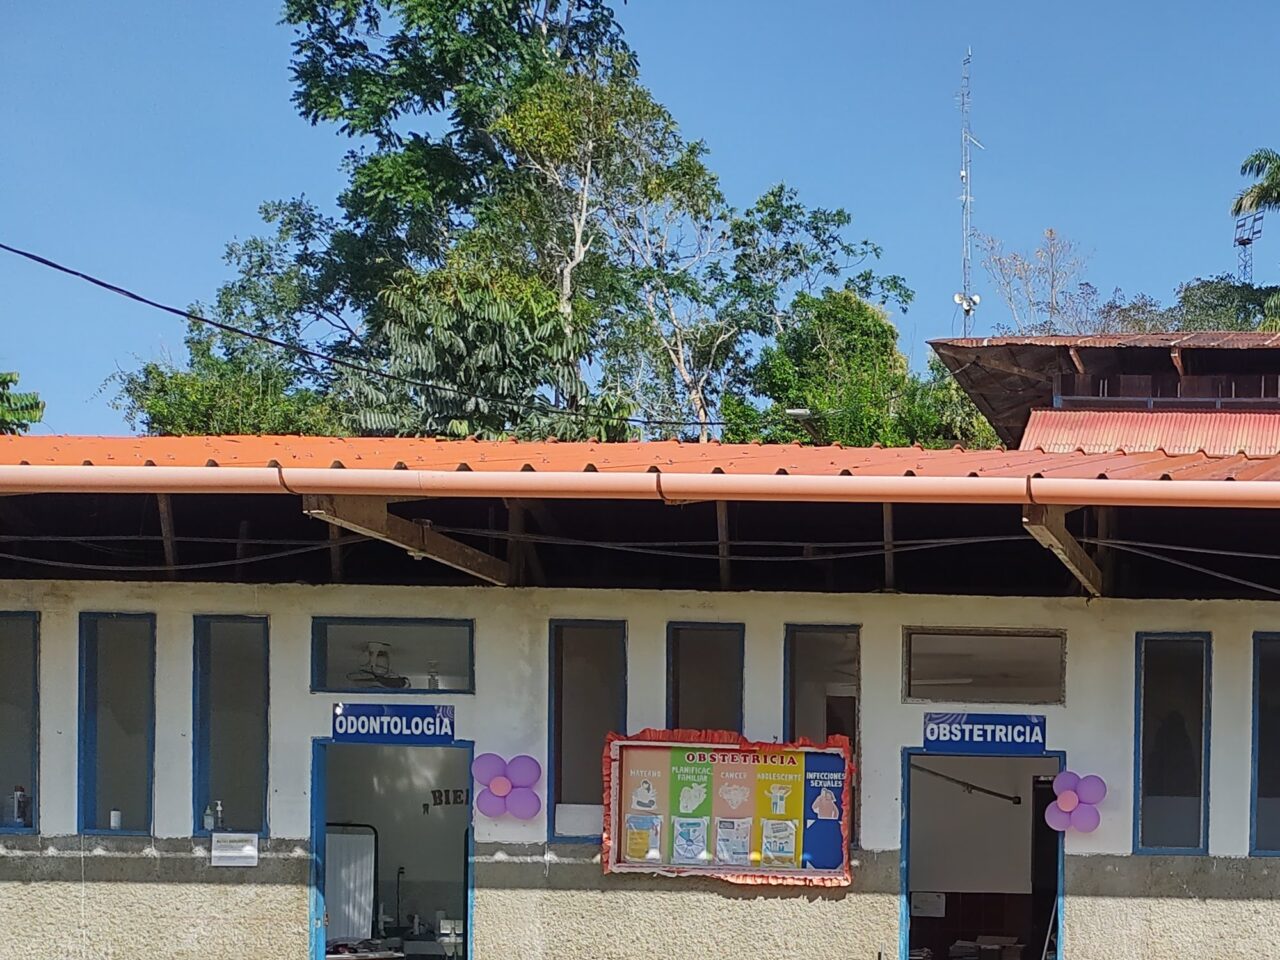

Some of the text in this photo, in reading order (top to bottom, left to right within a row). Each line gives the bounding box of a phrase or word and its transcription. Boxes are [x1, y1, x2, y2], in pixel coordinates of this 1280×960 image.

[335, 713, 452, 736] ODONTOLOGÍA
[926, 723, 1043, 742] OBSTETRICIA
[685, 752, 798, 766] OBSTETRICIA
[677, 774, 708, 782] FAMILIAR
[806, 771, 846, 780] INFECCIONES
[810, 780, 843, 788] SEXUALES
